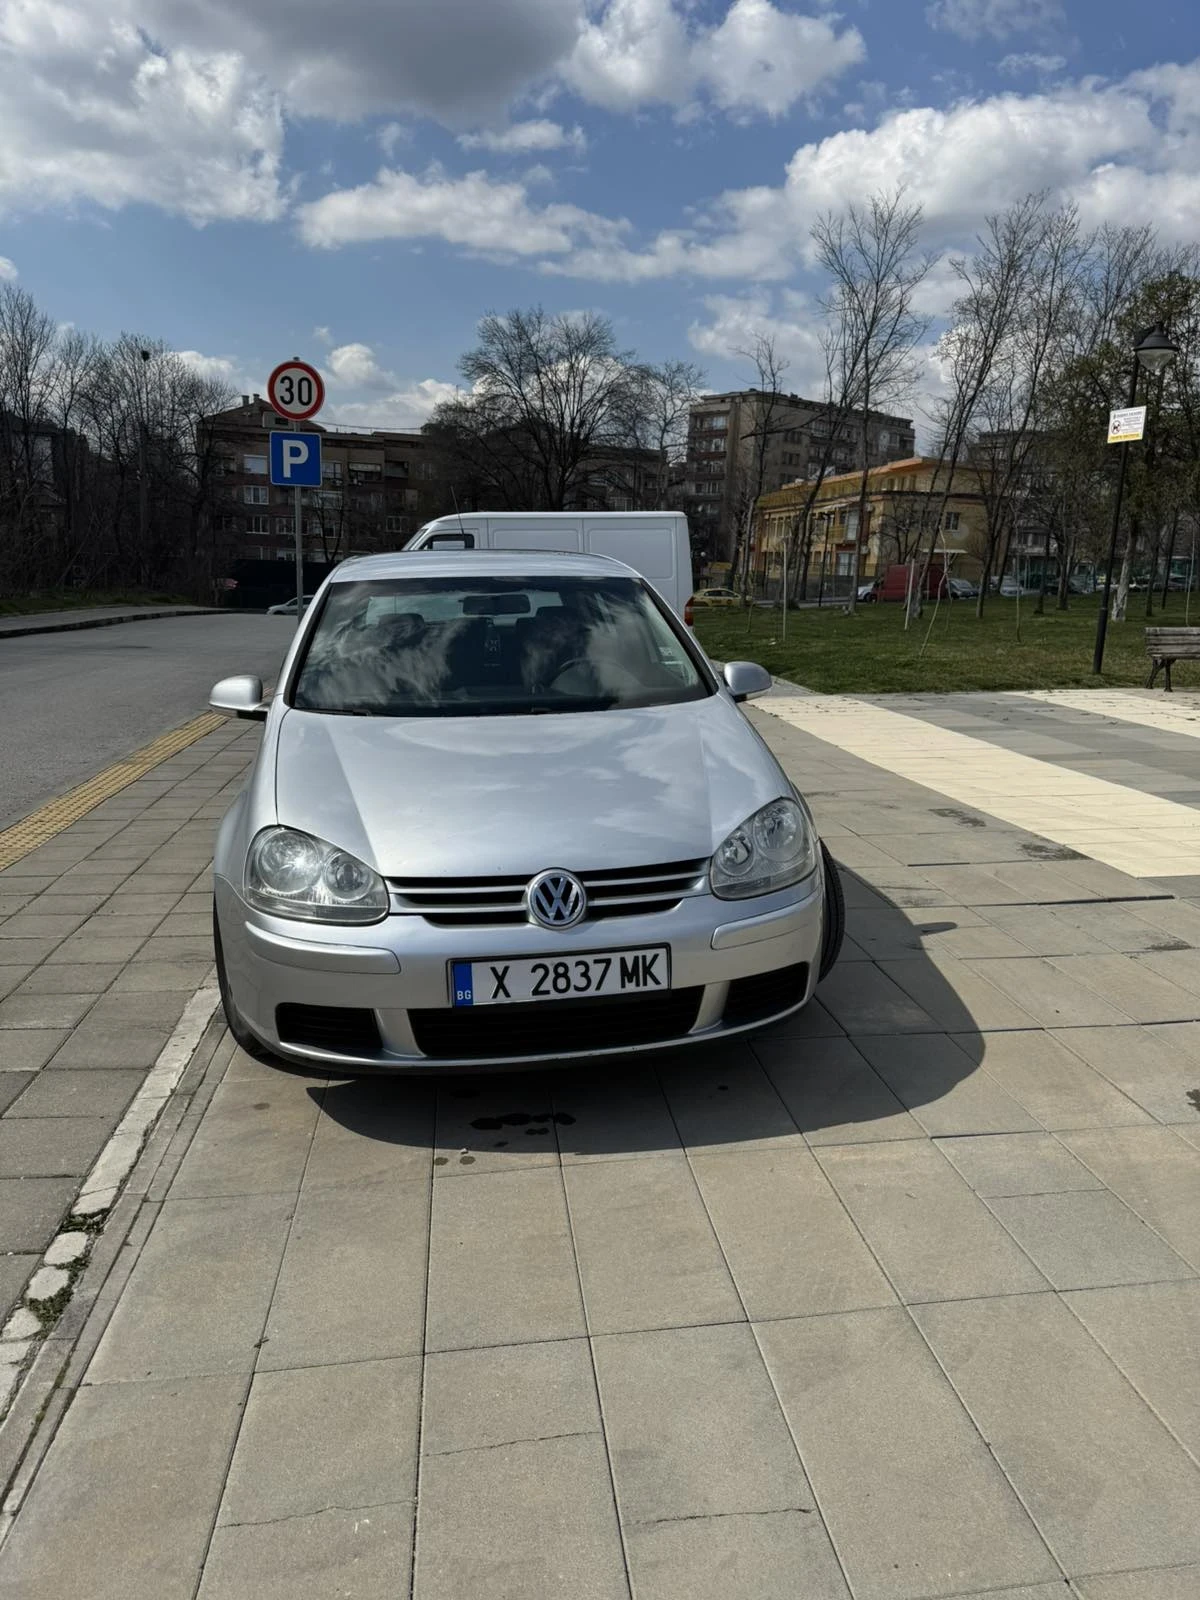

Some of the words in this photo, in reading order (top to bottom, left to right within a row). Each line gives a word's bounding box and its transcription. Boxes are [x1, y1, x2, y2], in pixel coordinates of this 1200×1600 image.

[280, 376, 312, 406] 30
[282, 439, 308, 478] P
[533, 873, 580, 922] VW
[457, 990, 471, 1000] BG
[490, 965, 511, 999] X
[530, 957, 612, 996] 2837
[619, 953, 661, 989] MK
